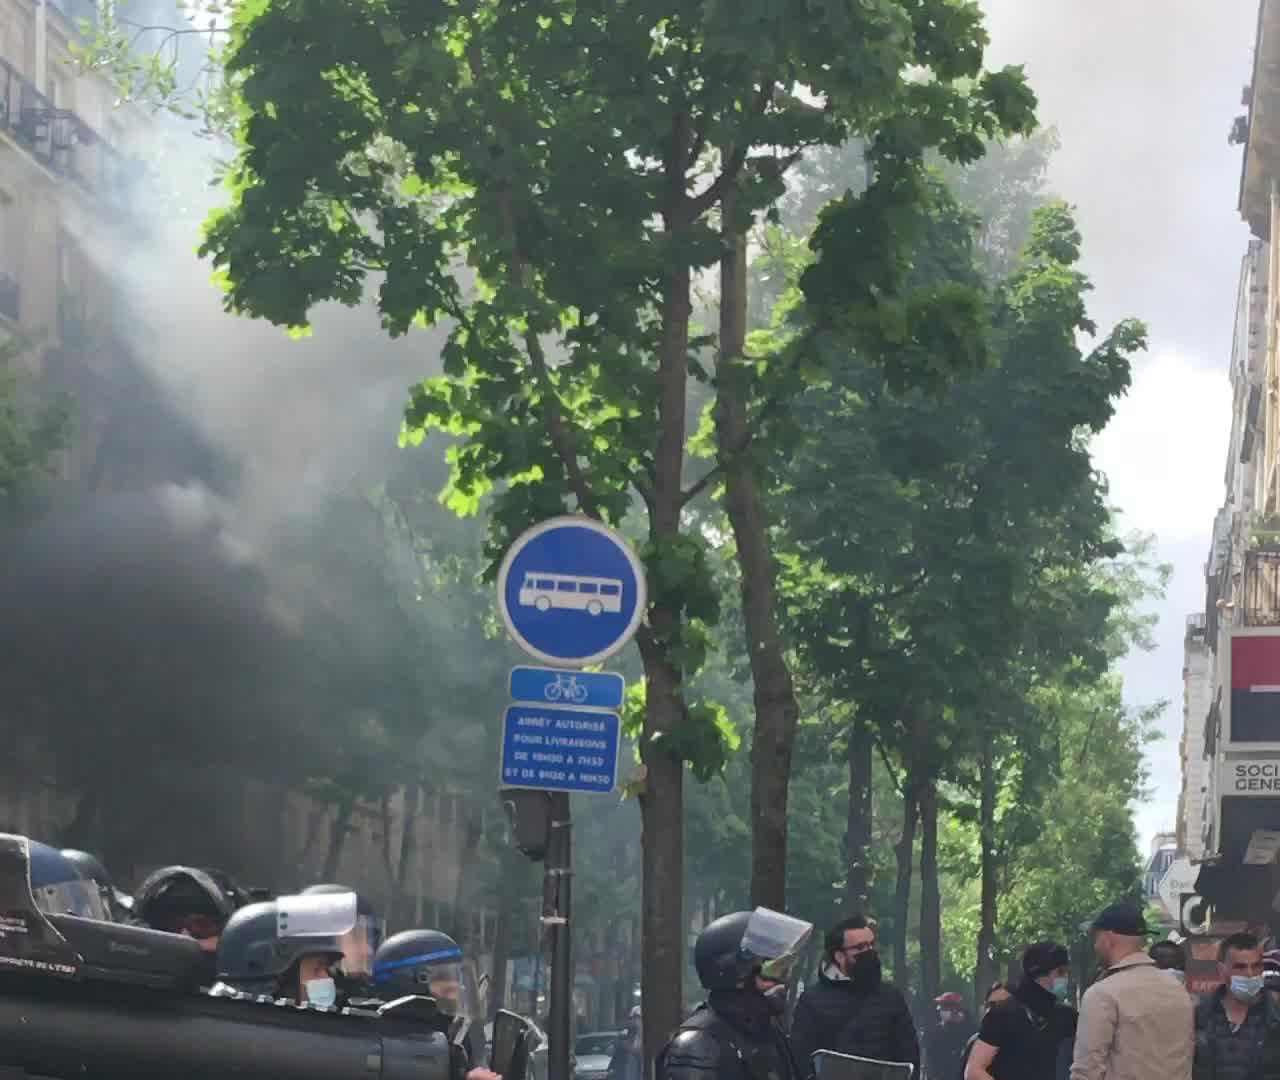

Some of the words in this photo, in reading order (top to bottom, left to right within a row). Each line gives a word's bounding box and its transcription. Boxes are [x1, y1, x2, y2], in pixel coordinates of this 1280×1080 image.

[513, 733, 543, 745] POUR
[545, 736, 608, 749] LIVRAISONS
[513, 751, 529, 761] DE
[504, 767, 519, 777] ET
[521, 768, 535, 779] DE
